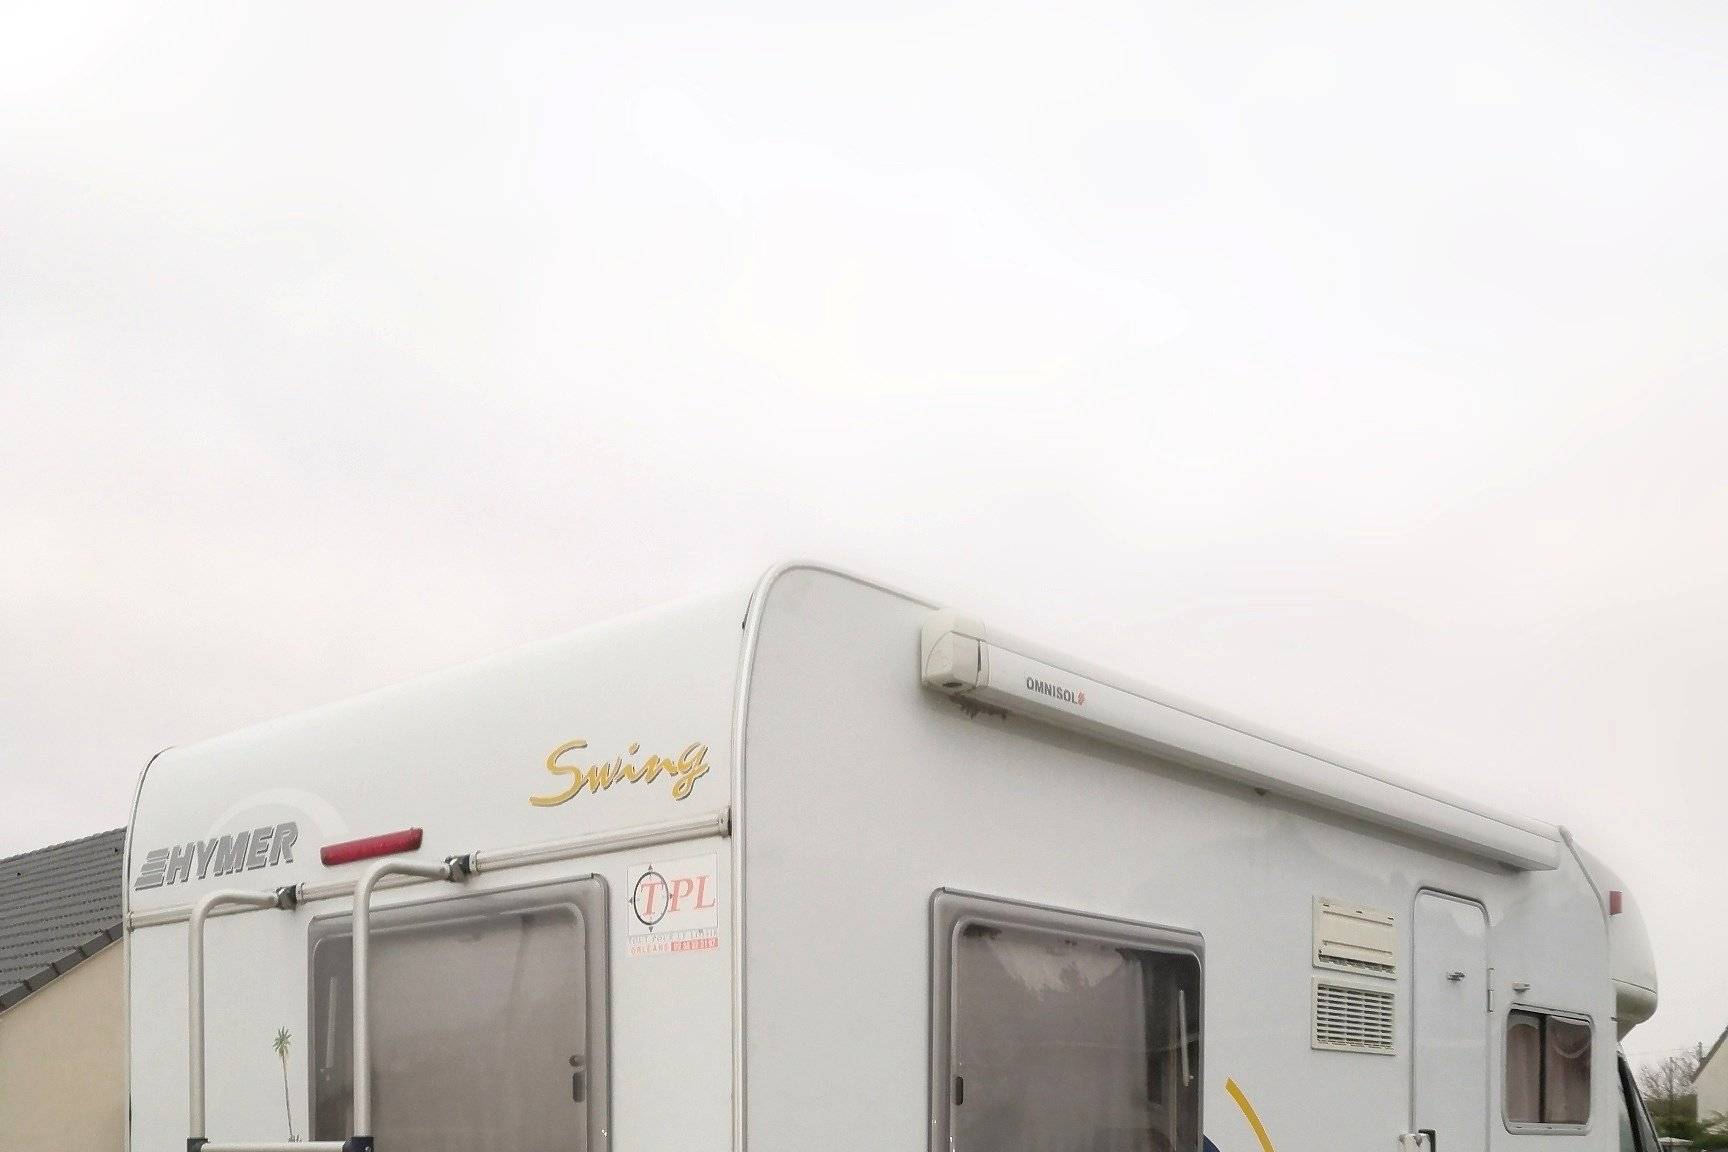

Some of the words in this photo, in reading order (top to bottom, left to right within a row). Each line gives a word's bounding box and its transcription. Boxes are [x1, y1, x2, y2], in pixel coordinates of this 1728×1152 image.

[1026, 677, 1078, 705] OMNISOL
[529, 739, 710, 808] Swing
[165, 821, 299, 886] HYMER
[640, 874, 716, 917] TPL
